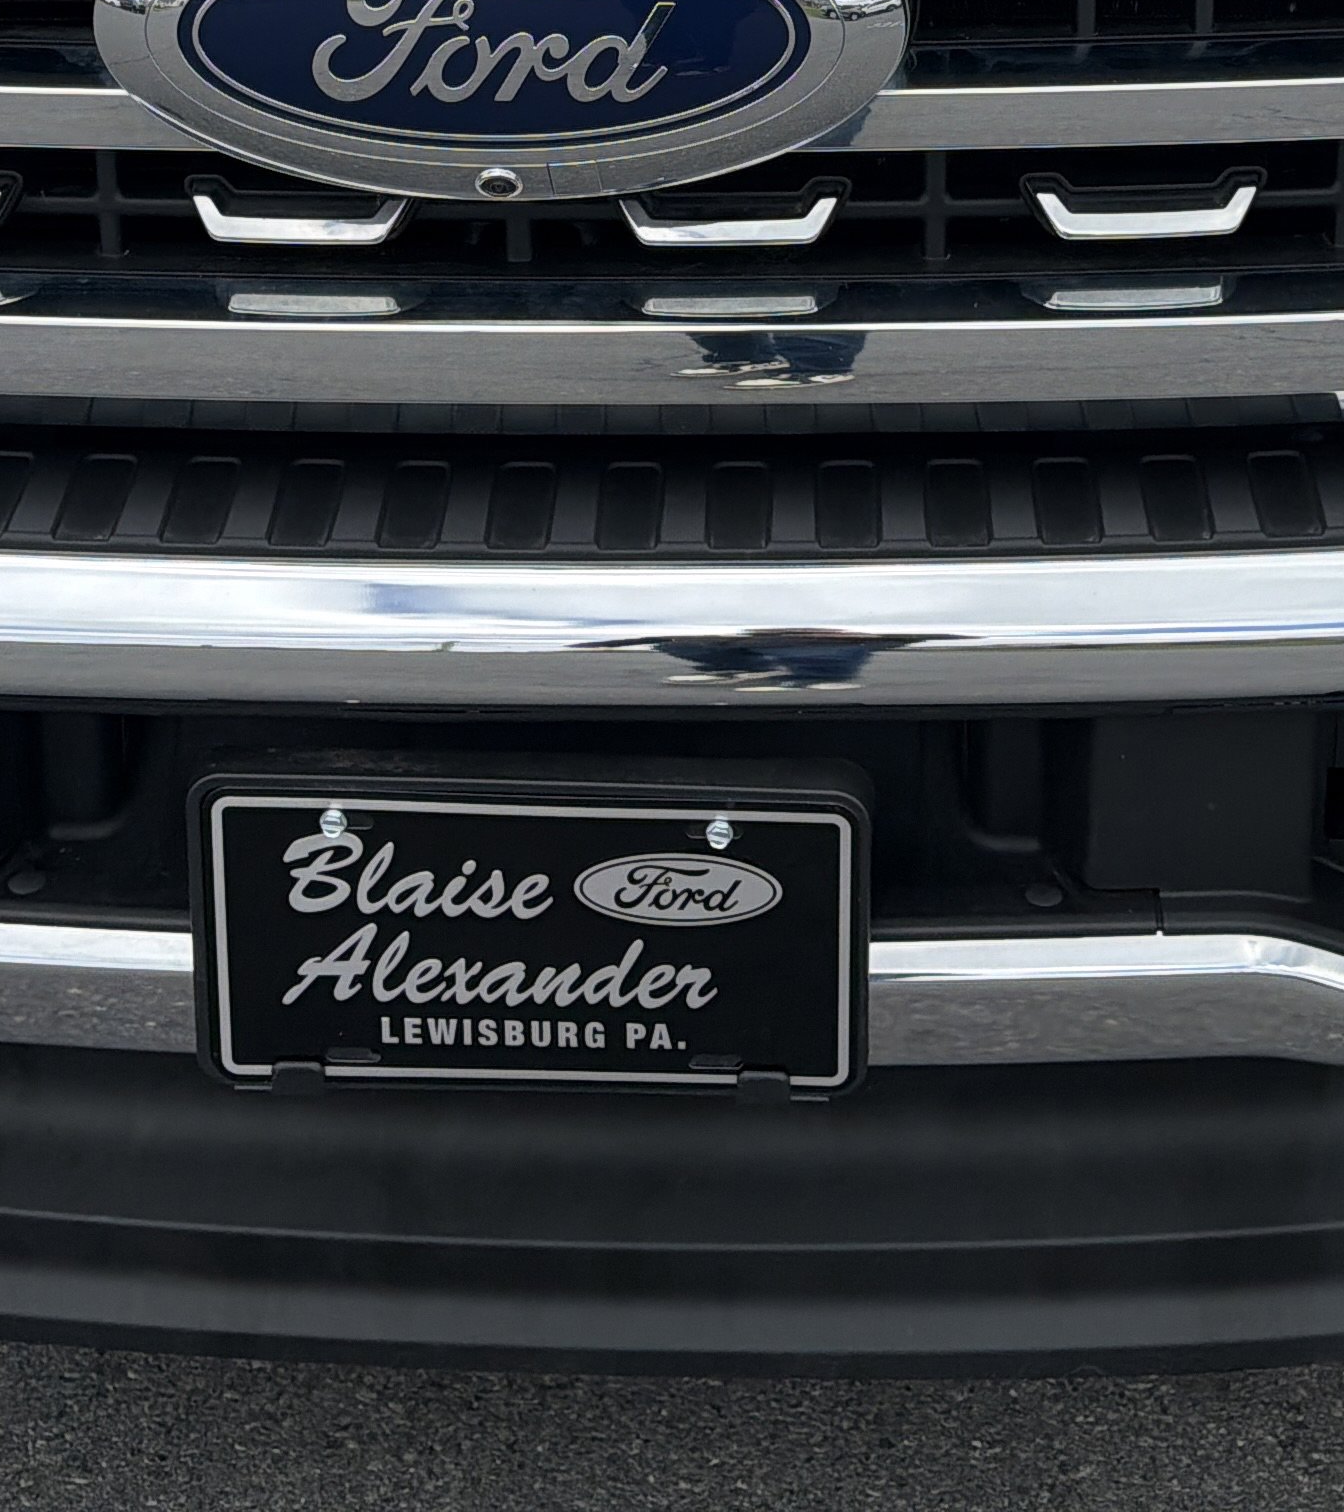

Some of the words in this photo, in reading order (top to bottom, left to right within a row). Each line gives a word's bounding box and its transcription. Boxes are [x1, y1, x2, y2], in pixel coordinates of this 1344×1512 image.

[281, 831, 554, 921] Blaise
[613, 864, 740, 914] Ford
[281, 922, 719, 1010] Alexander
[380, 1017, 607, 1050] LEWISBURG
[626, 1022, 687, 1051] PA.
